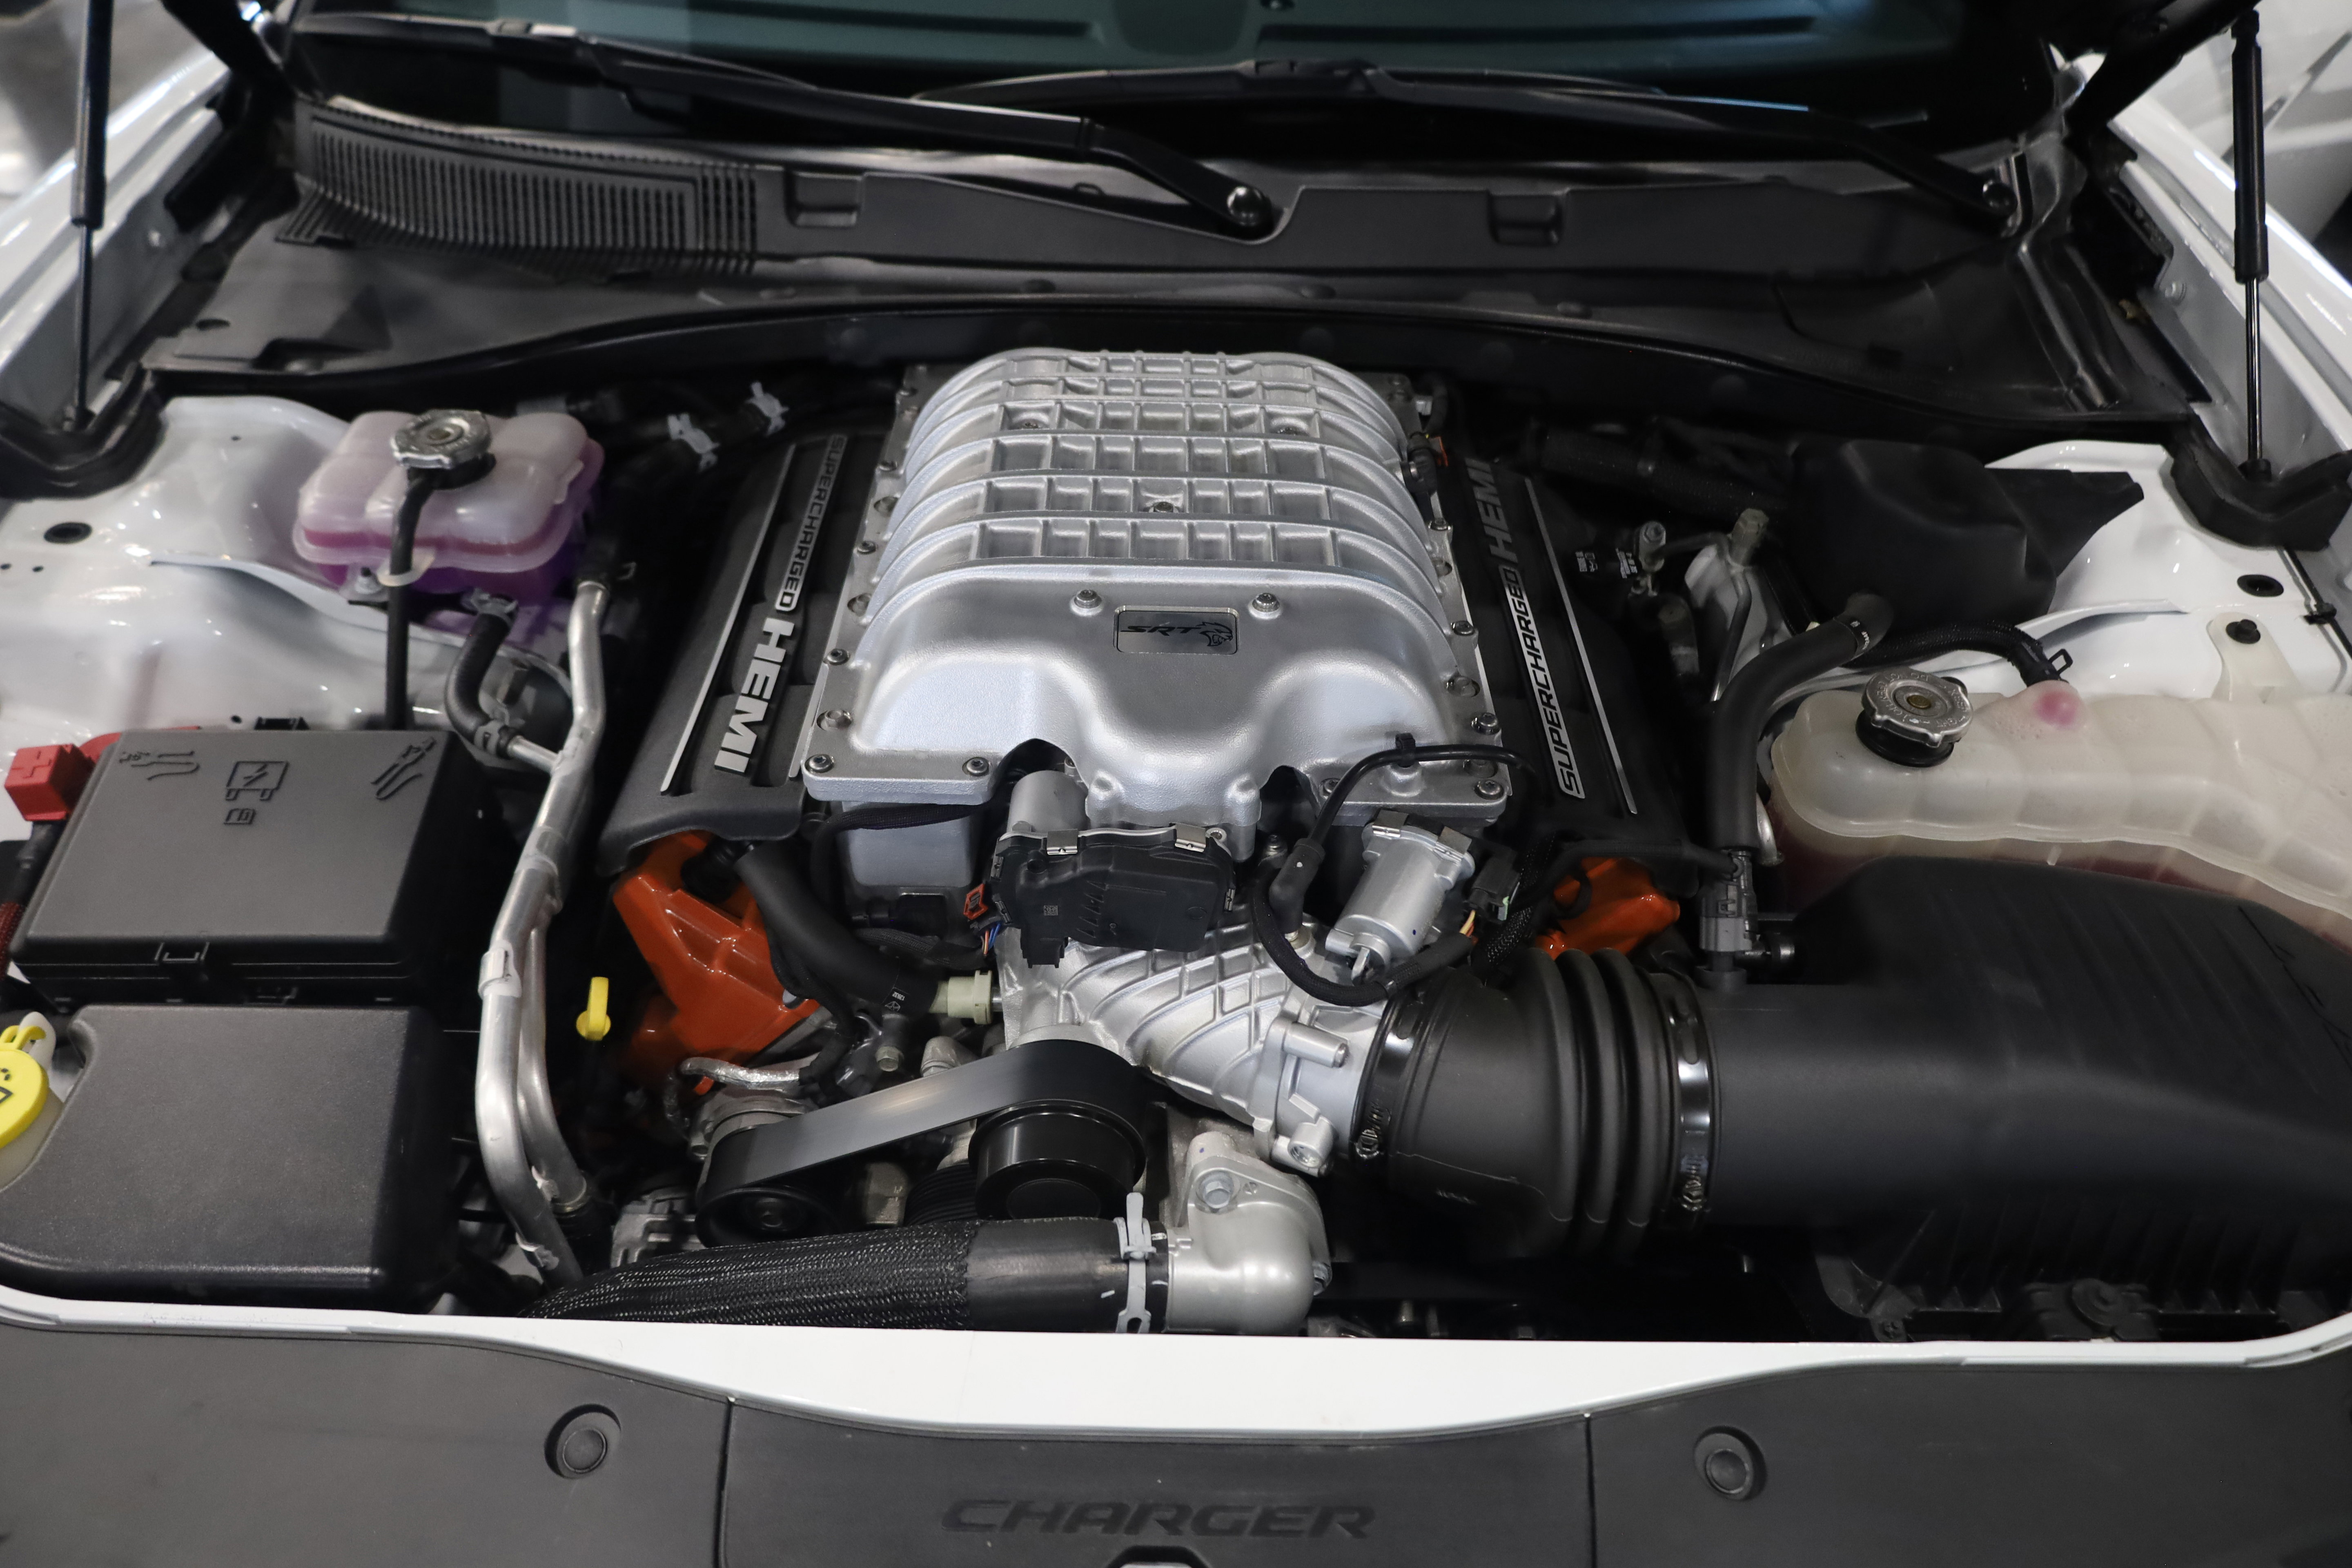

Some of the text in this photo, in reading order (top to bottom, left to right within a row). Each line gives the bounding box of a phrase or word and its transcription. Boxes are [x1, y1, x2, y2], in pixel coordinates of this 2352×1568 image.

[714, 434, 846, 773] SUPERCHARGED HEMI
[1120, 625, 1201, 636] SRT
[1465, 458, 1583, 796] SUPERCHARGED HEMI
[941, 1499, 1376, 1539] CHARGER
